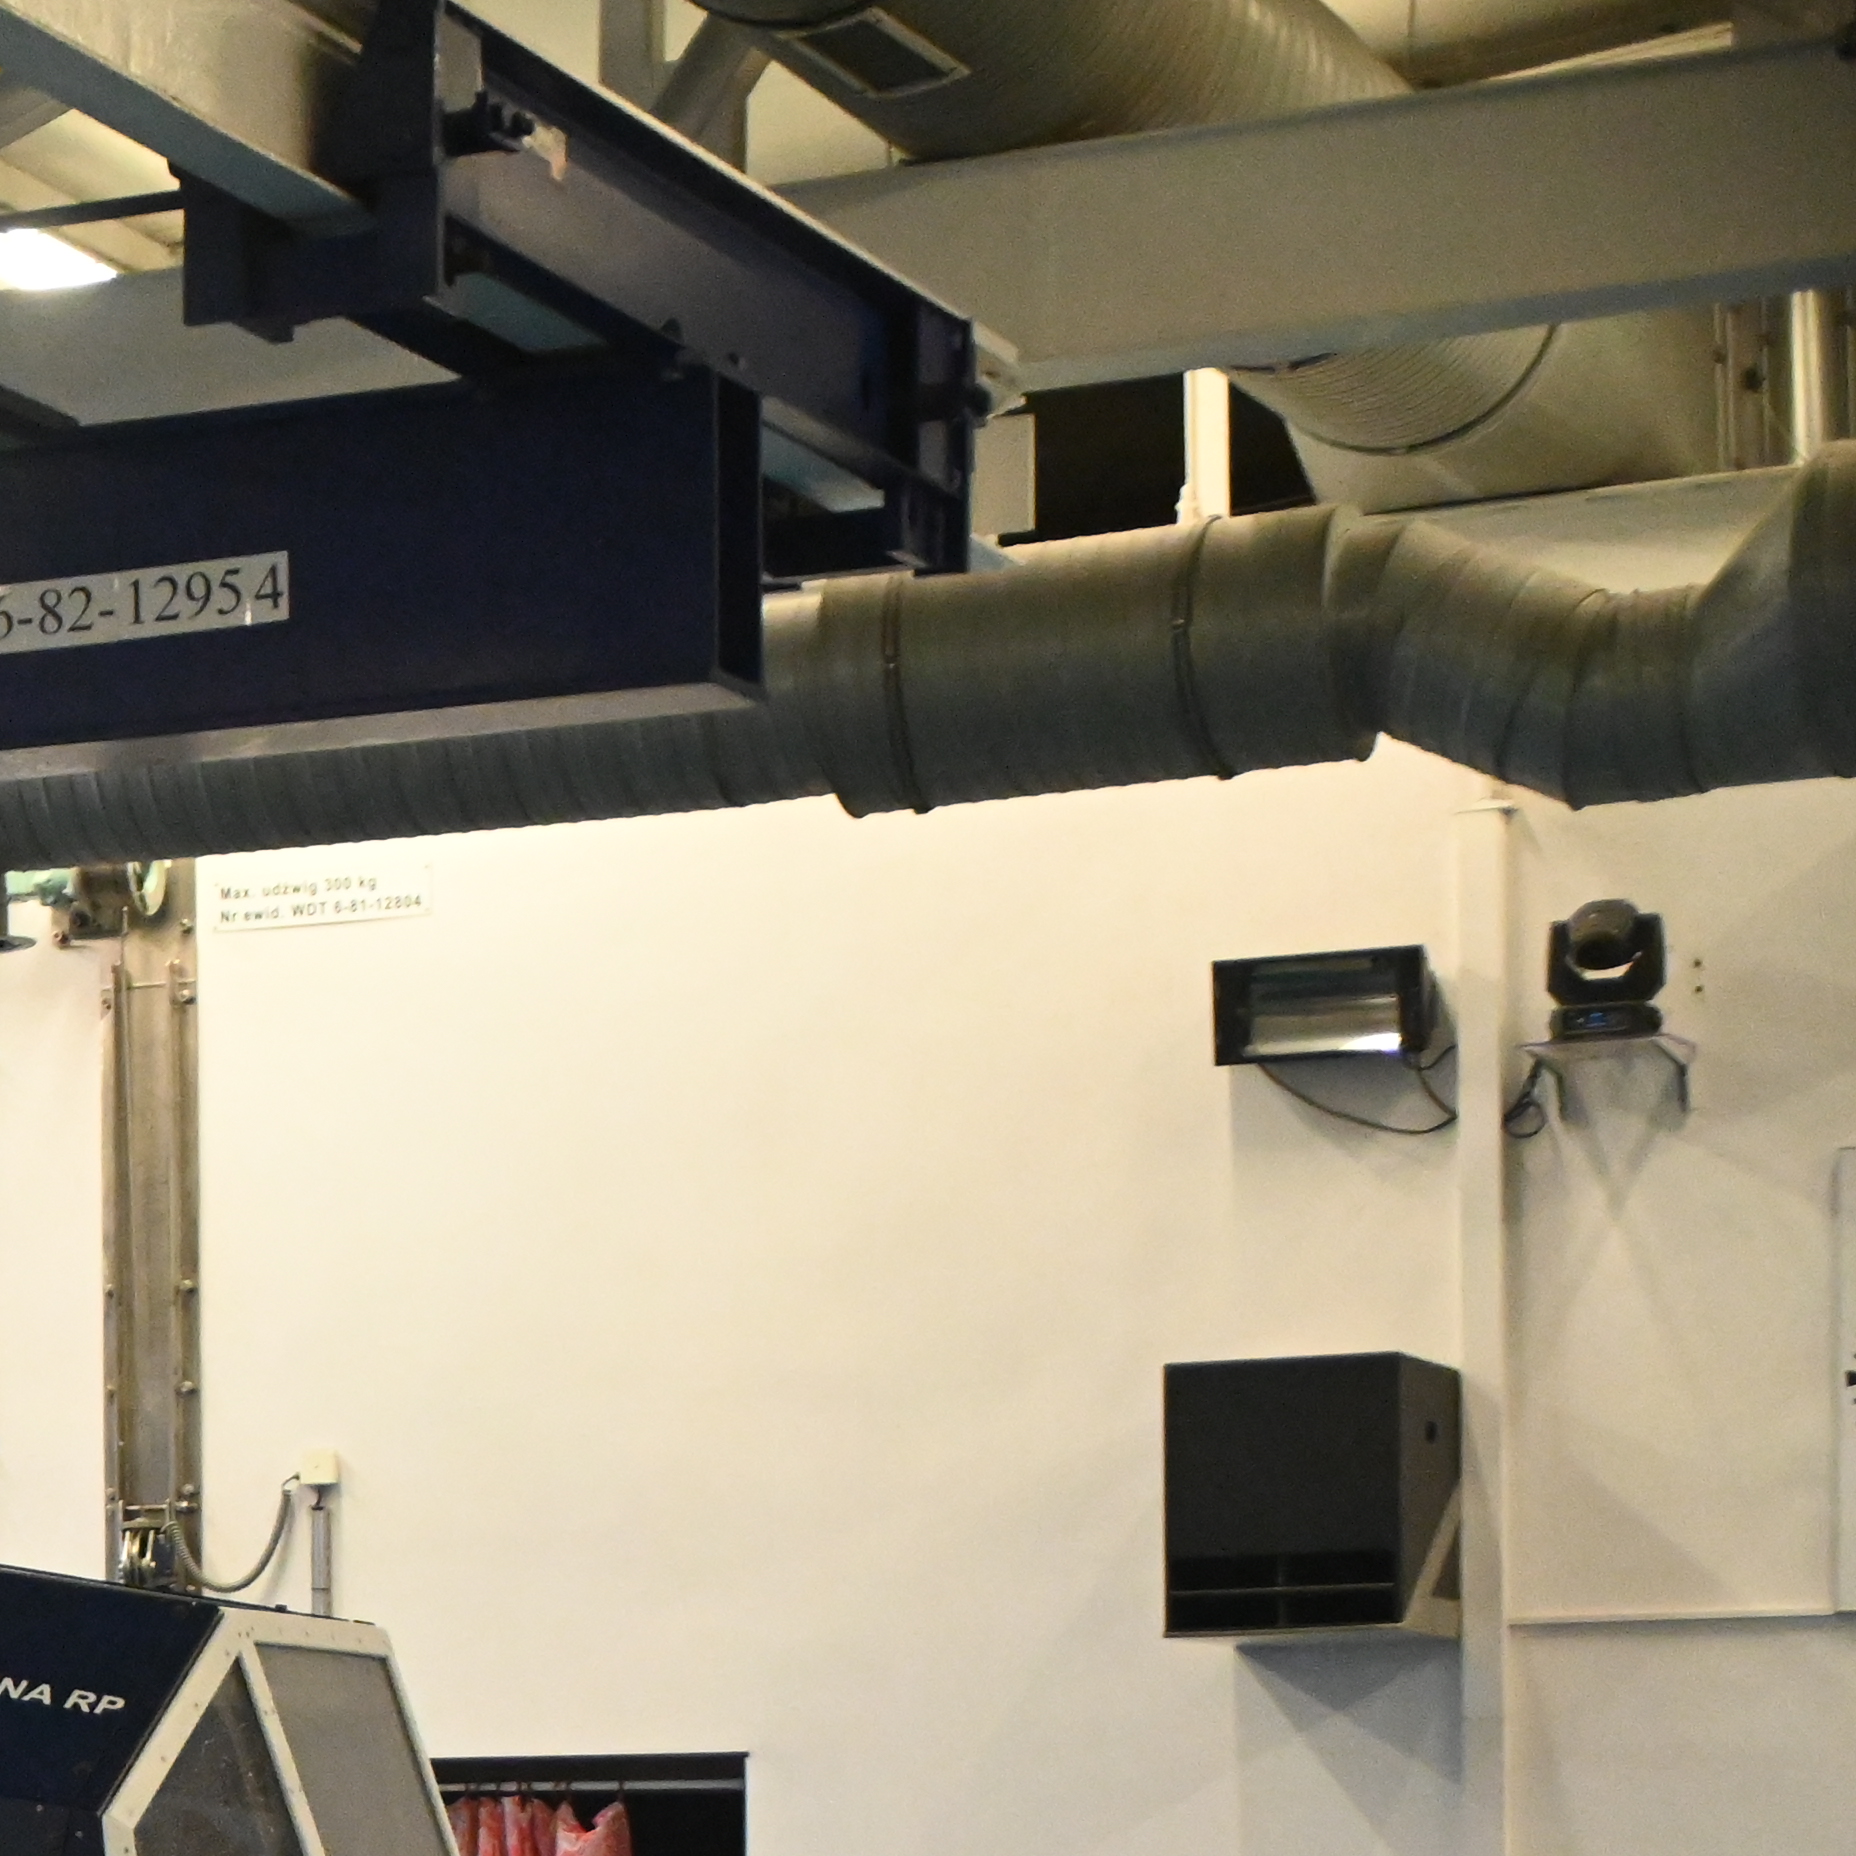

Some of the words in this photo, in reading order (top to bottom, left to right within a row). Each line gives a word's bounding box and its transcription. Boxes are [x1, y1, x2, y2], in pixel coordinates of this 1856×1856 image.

[358, 875, 377, 891] kg
[220, 909, 238, 923] Nr
[292, 901, 327, 917] WDT
[63, 1690, 127, 1717] RP
